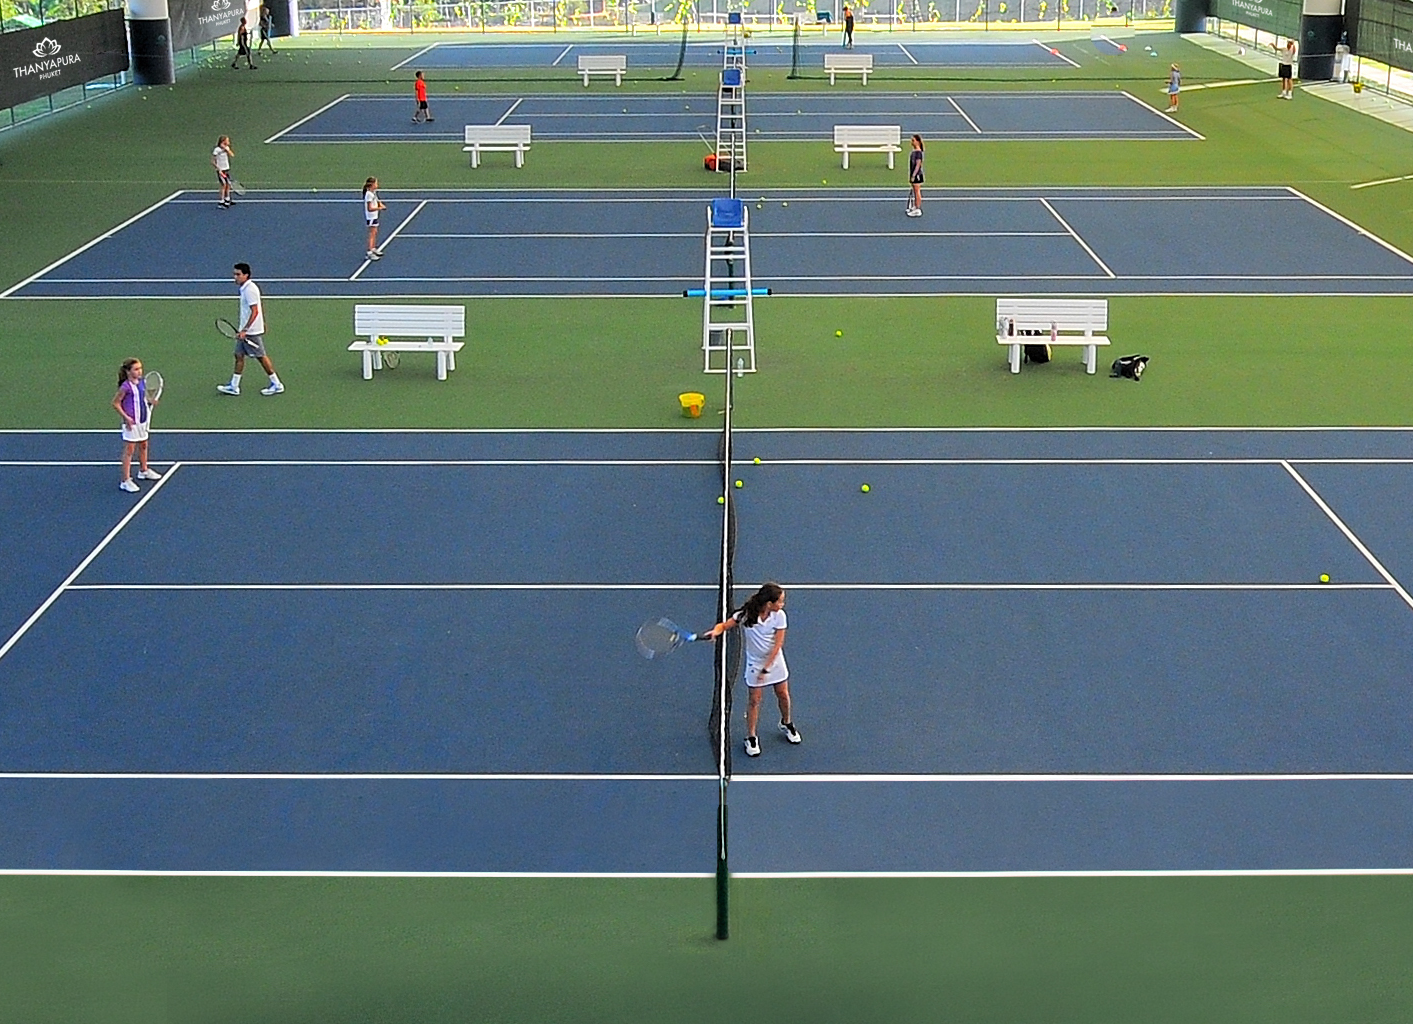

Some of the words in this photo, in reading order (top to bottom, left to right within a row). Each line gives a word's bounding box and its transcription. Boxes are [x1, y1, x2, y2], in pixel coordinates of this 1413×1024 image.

[197, 8, 245, 25] THANYAPURA
[13, 53, 82, 78] THANYAPURA
[39, 69, 62, 81] PHUKET
